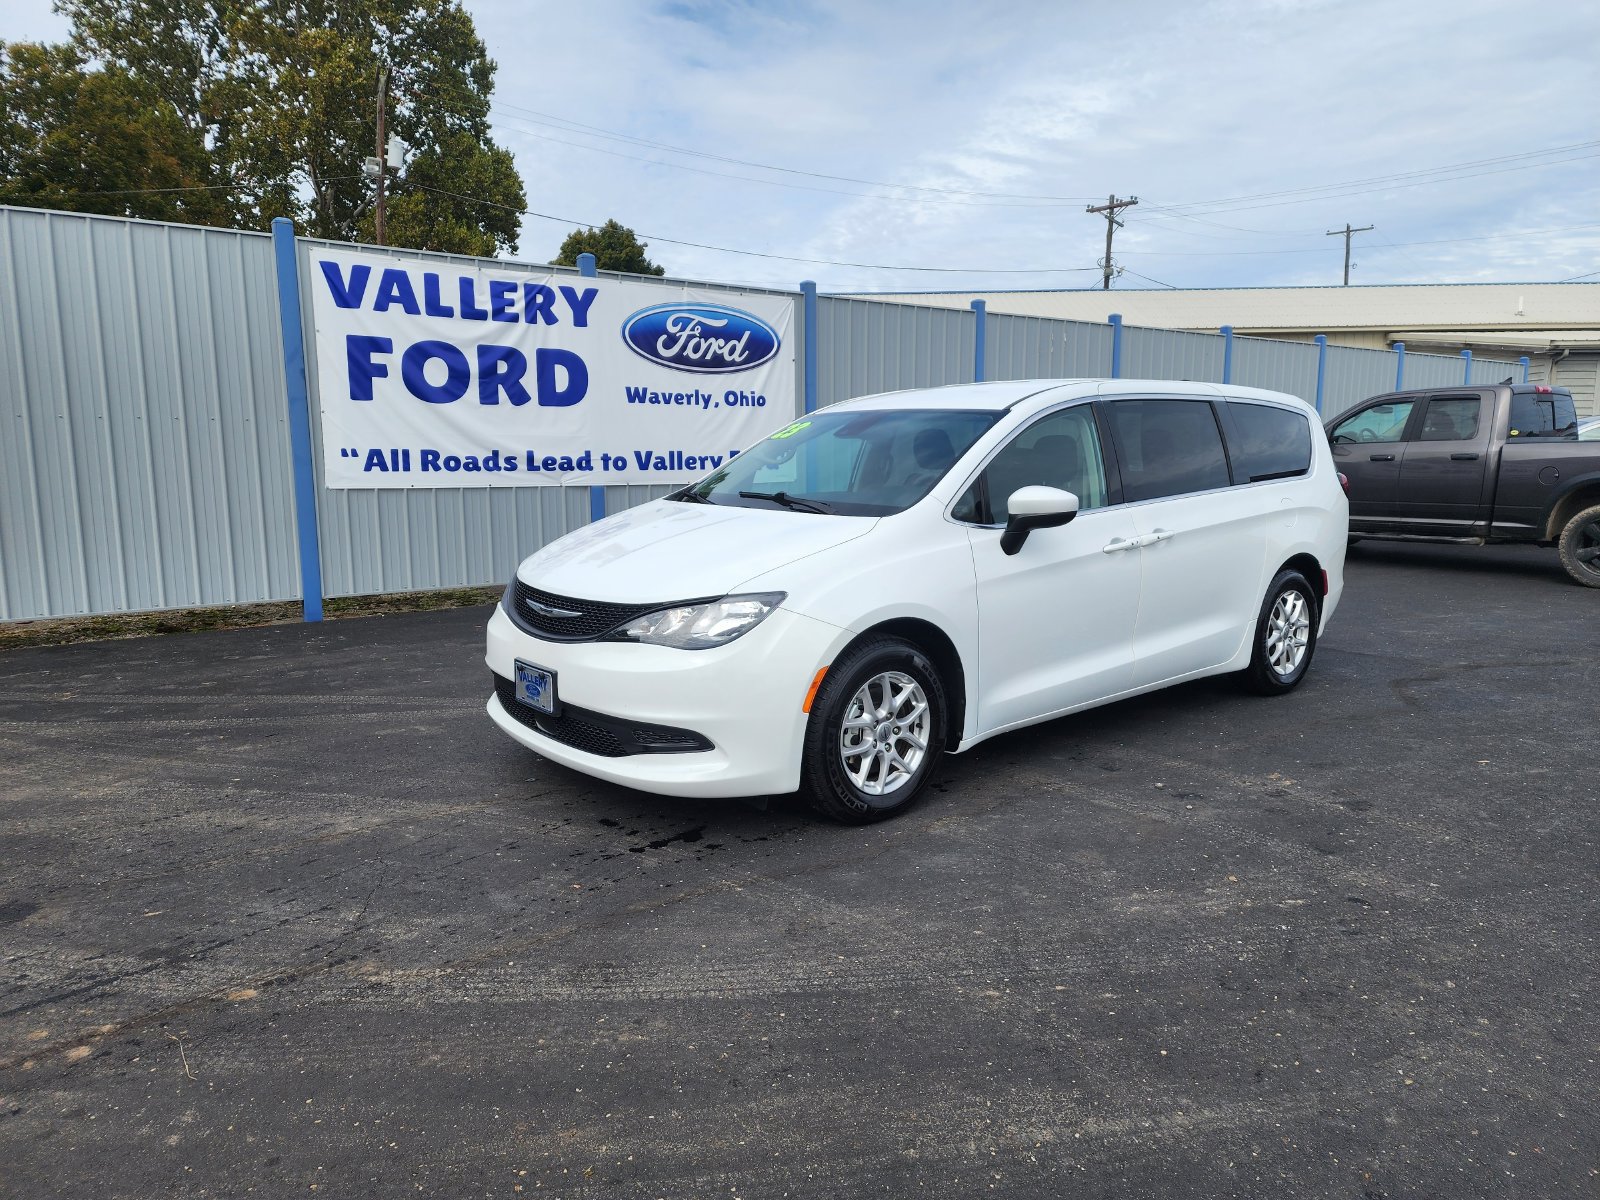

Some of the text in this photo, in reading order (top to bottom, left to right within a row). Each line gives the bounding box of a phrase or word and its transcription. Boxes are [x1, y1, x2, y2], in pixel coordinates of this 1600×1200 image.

[318, 260, 598, 327] VALLERY
[655, 313, 751, 364] Ford
[345, 334, 588, 407] FORD
[625, 386, 767, 410] Waverly, Ohio
[420, 449, 520, 473] Roads
[526, 450, 594, 472] Lead
[600, 453, 628, 472] to
[633, 450, 724, 473] Vallery
[518, 671, 548, 691] VALLERY
